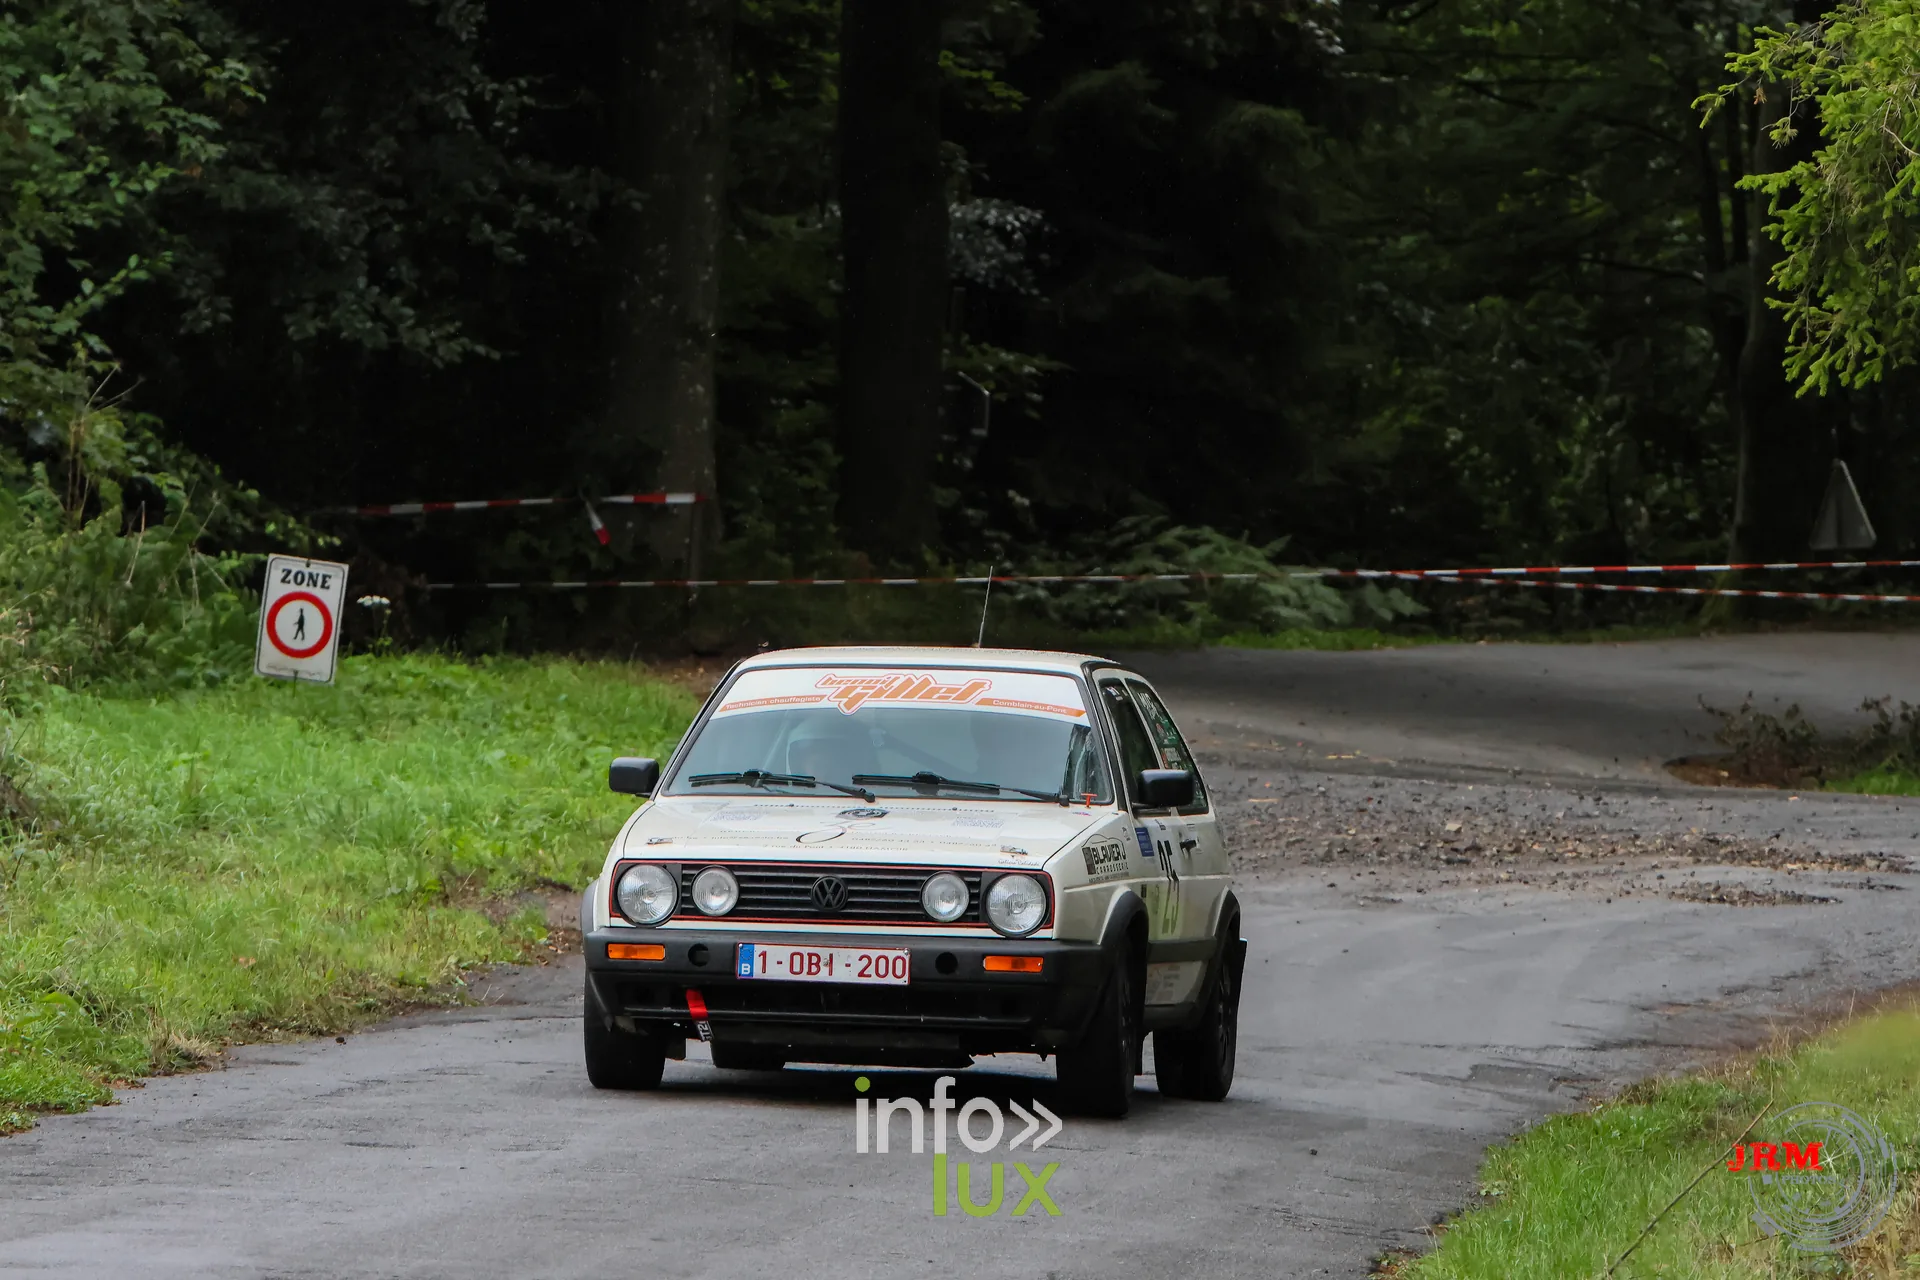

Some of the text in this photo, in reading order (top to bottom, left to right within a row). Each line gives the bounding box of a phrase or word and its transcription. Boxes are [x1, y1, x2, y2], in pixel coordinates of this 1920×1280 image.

[280, 568, 332, 589] ZONE
[992, 698, 1068, 714] Comblain-au-Pont
[741, 962, 751, 975] B
